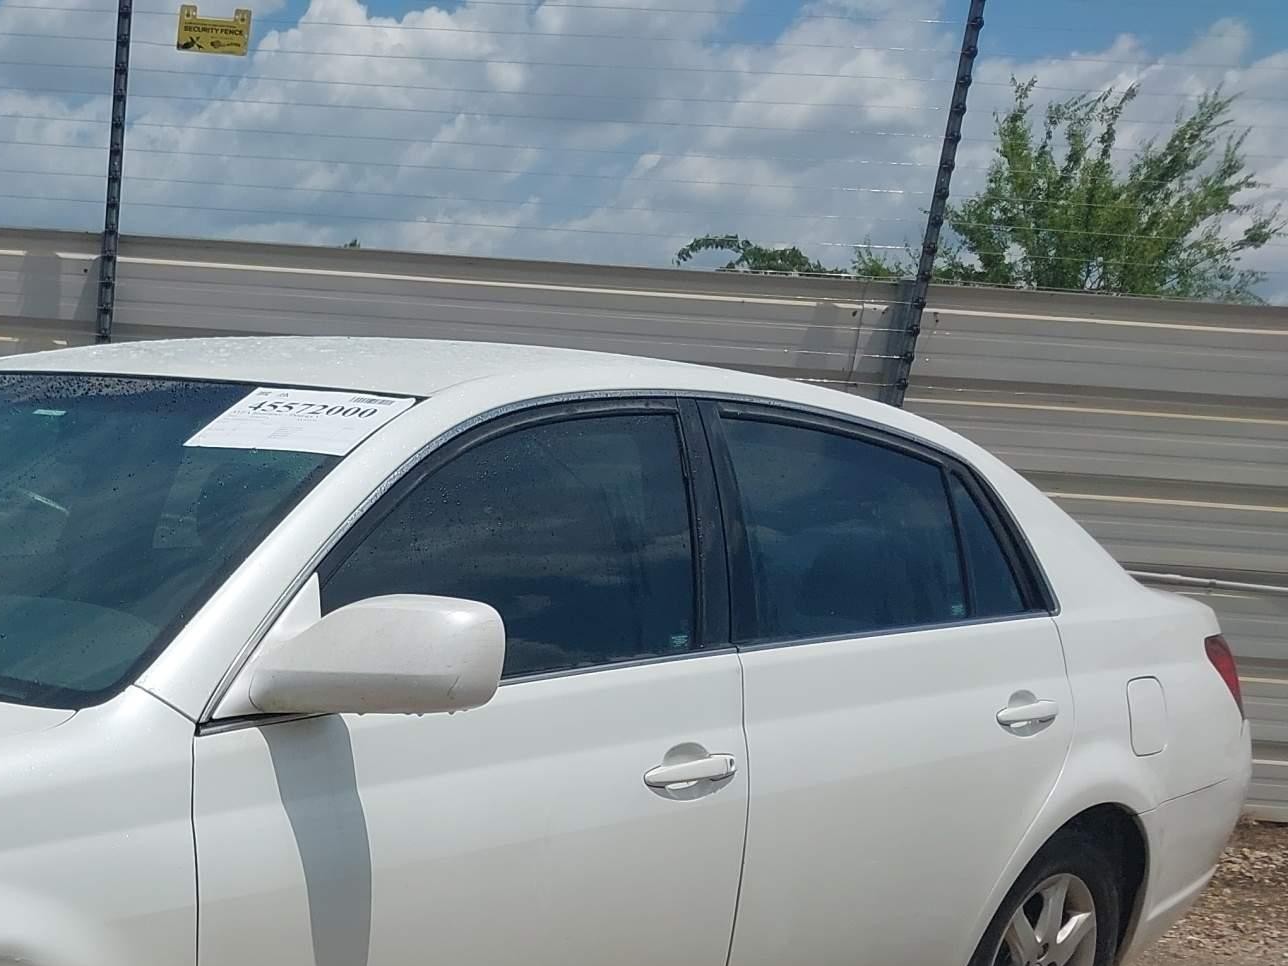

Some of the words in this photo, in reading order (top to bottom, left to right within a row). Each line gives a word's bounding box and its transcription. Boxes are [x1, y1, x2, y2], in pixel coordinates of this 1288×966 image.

[184, 25, 219, 34] SECURITY
[221, 28, 243, 36] FENCE
[248, 400, 378, 418] 45572000
